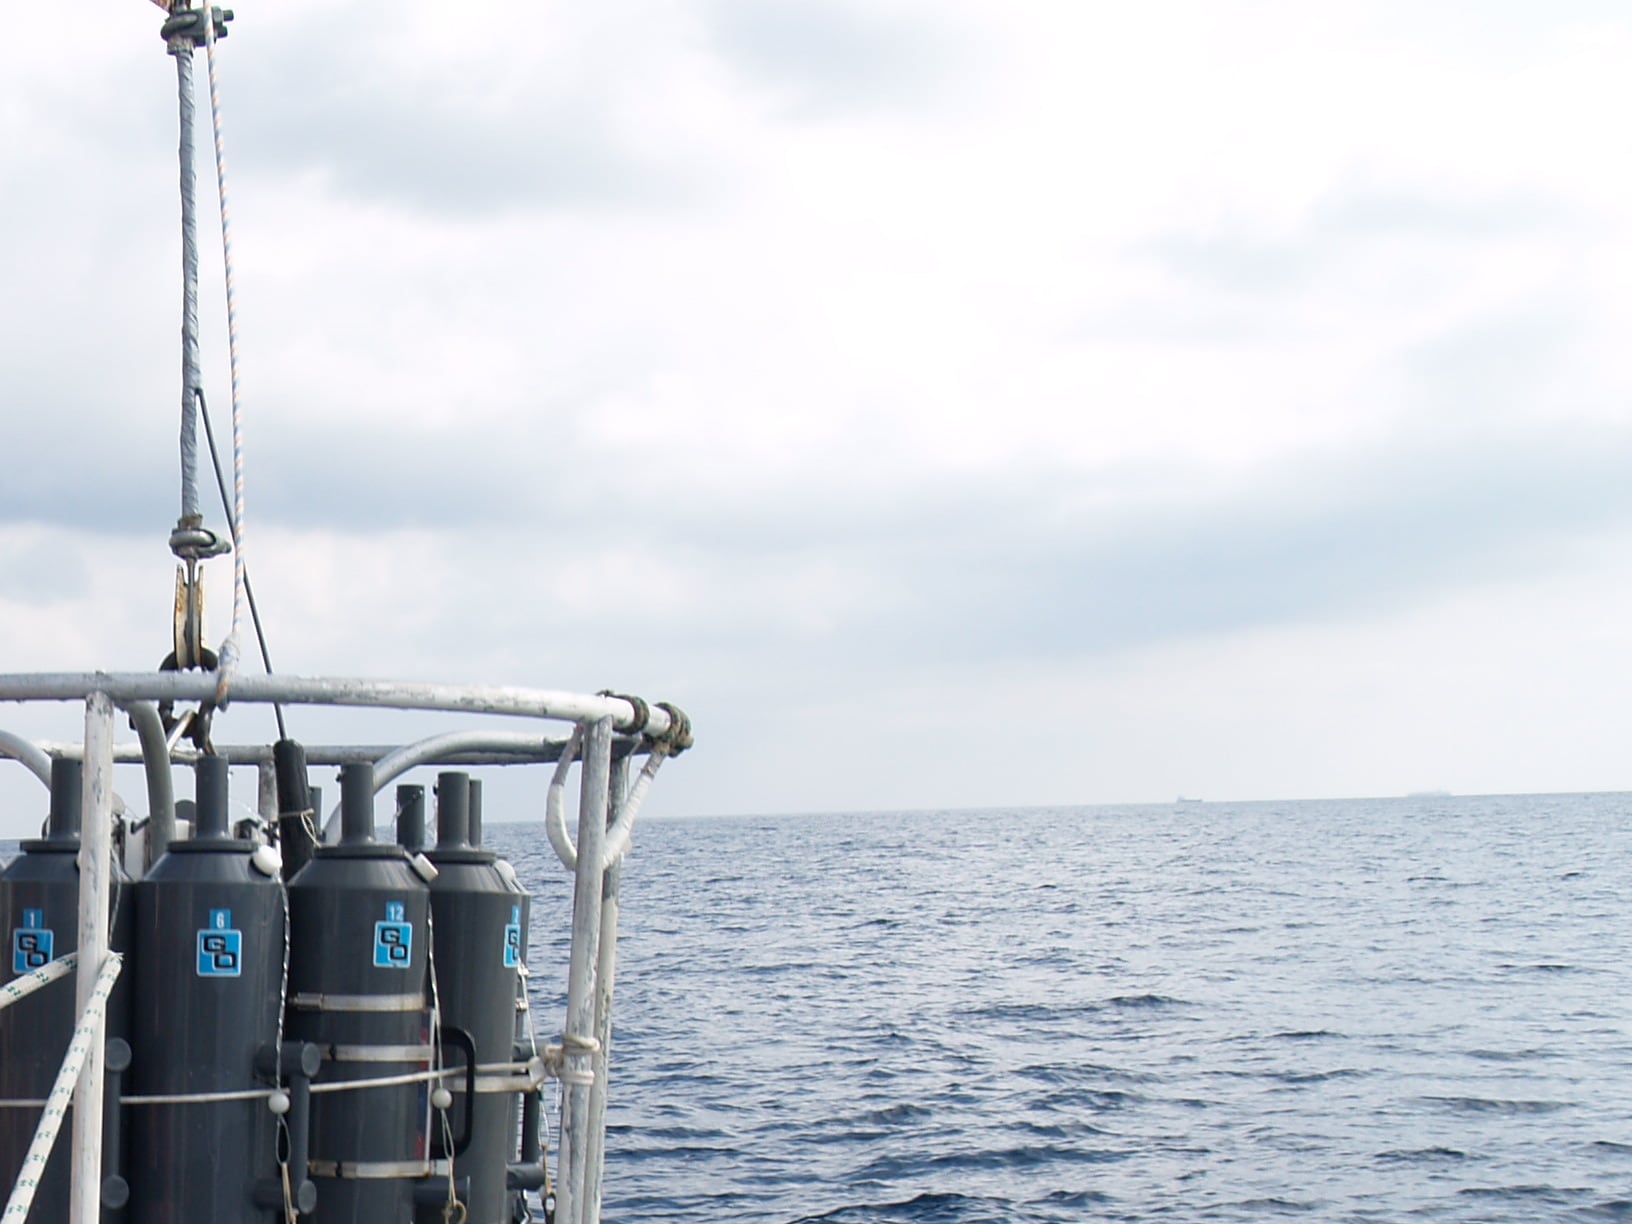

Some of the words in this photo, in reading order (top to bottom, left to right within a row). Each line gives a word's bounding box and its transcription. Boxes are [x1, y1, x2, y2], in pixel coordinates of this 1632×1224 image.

[28, 911, 36, 928] 1
[215, 912, 225, 928] 6
[389, 905, 404, 921] 12
